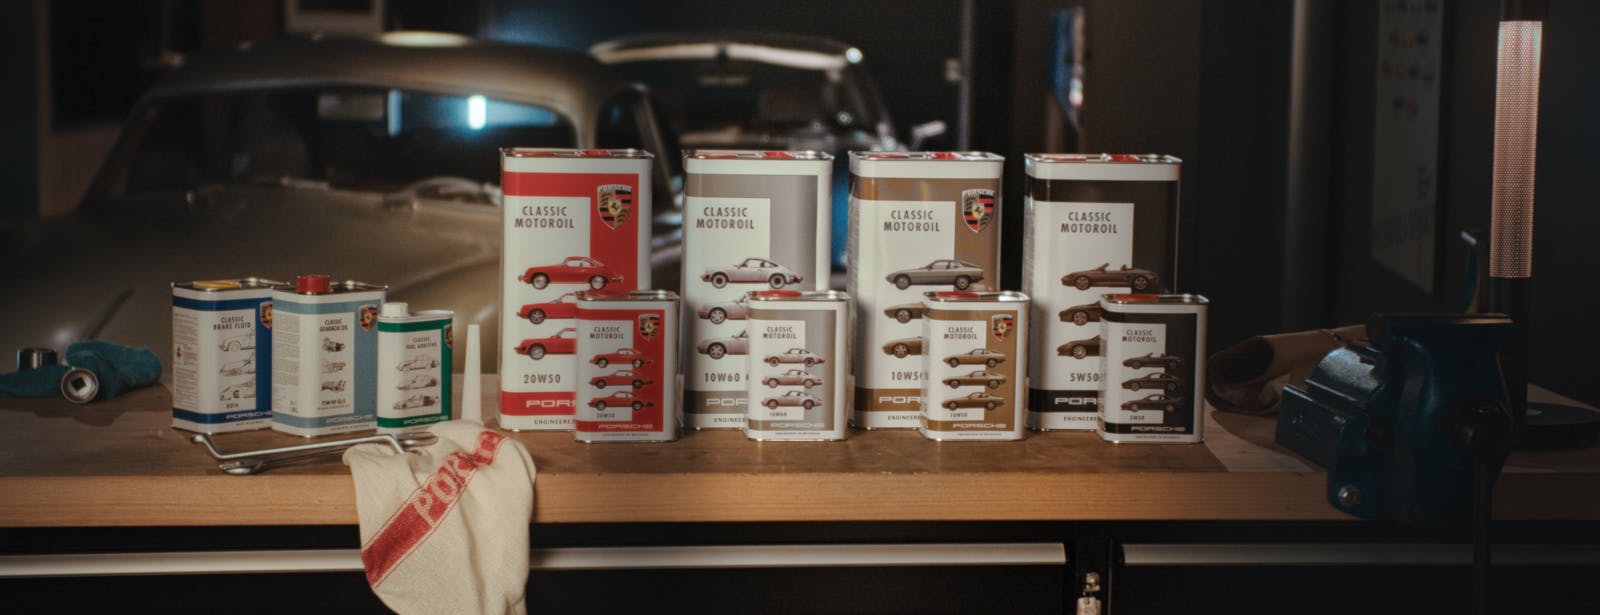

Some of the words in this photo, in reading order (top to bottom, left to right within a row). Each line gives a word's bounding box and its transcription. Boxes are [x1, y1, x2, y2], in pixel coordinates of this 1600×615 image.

[522, 206, 568, 216] CLASSIC
[703, 207, 748, 217] CLASSIC
[891, 210, 934, 220] CLASSIC
[1068, 212, 1111, 221] CLASSIC
[515, 218, 574, 229] MOTOROIL
[696, 219, 754, 229] MOTOROIL
[883, 221, 940, 232] MOTOROIL
[1060, 223, 1117, 233] MOTOROIL
[220, 316, 244, 324] CLASSIC
[234, 322, 252, 330] FLUID
[523, 374, 561, 384] 20W50
[704, 373, 741, 382] 10W60
[1069, 372, 1099, 382] 5W50
